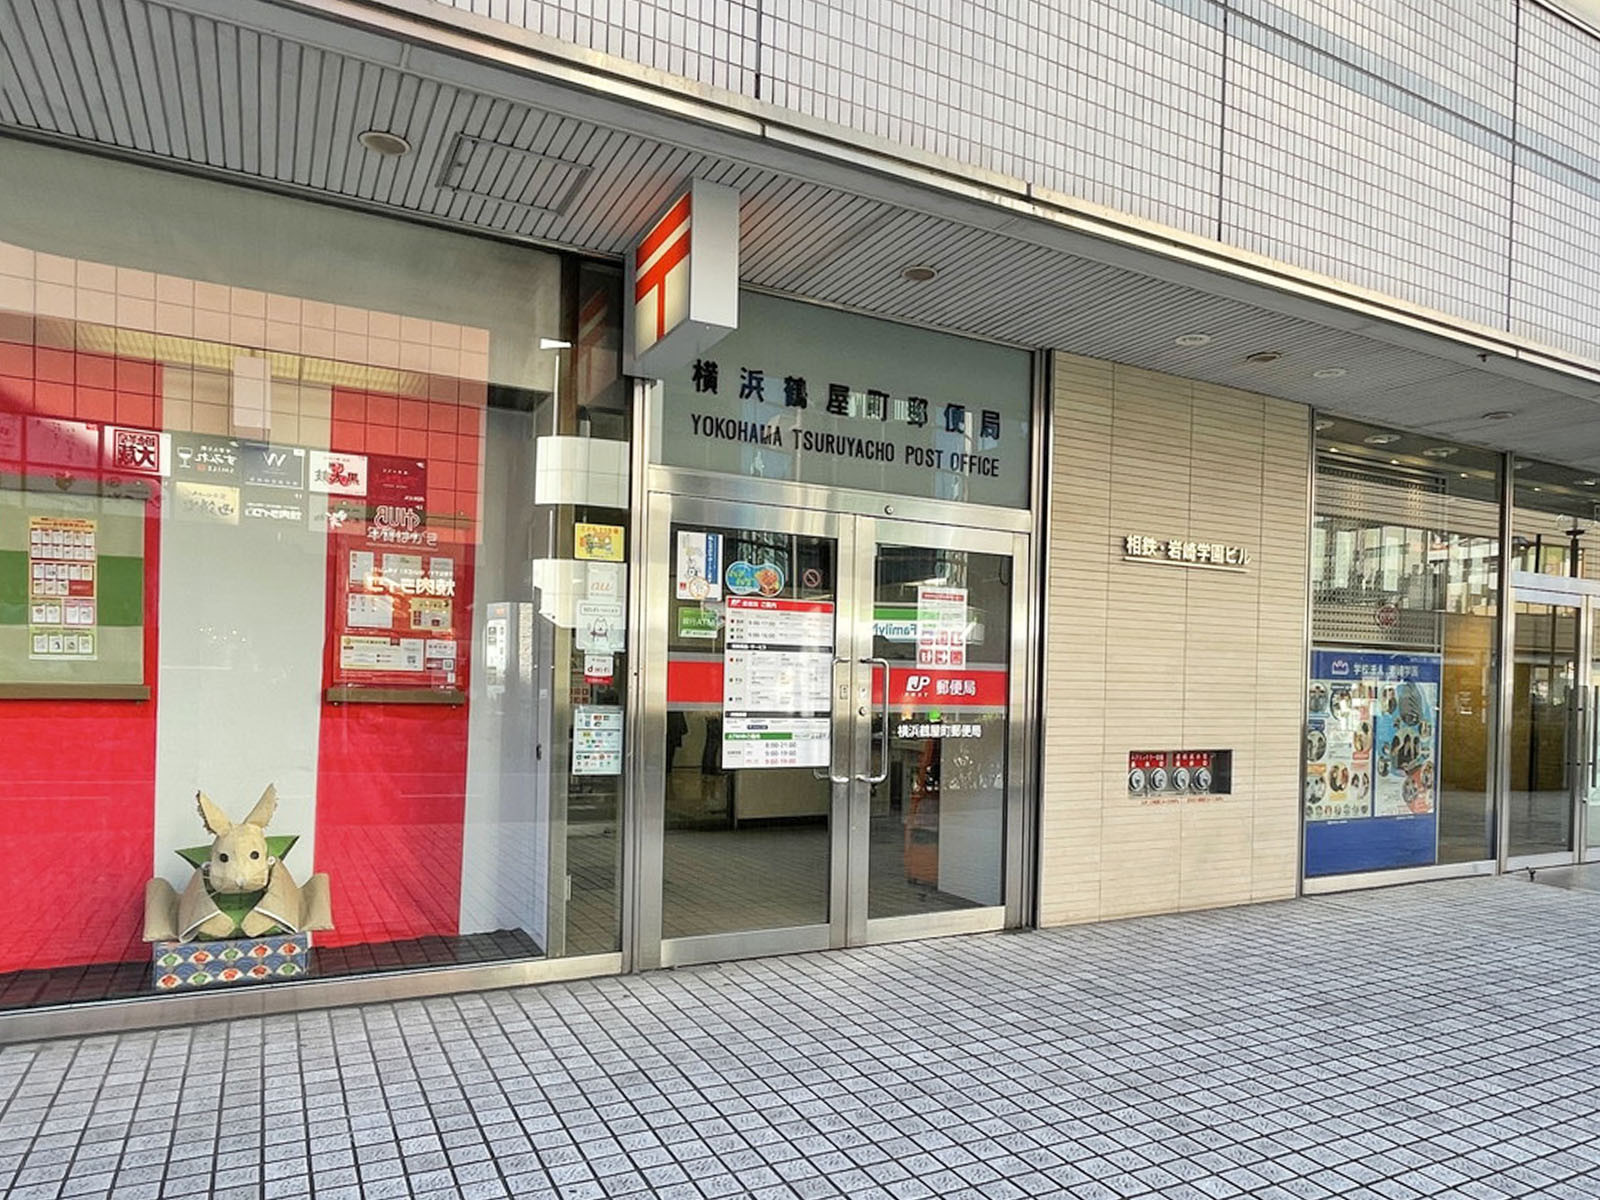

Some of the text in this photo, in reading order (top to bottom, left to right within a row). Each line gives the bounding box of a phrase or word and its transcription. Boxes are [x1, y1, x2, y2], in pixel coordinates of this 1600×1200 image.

[691, 359, 1001, 440] 横浜鶴屋町郵便局
[691, 414, 999, 478] YOKOHAMA TSURUYACHO POST OFFICE
[1126, 534, 1251, 565] 相鉄・岩崎学園ビル
[906, 675, 976, 697] JP 郵便局
[897, 723, 982, 738] 横浜鶴屋町郵便局
